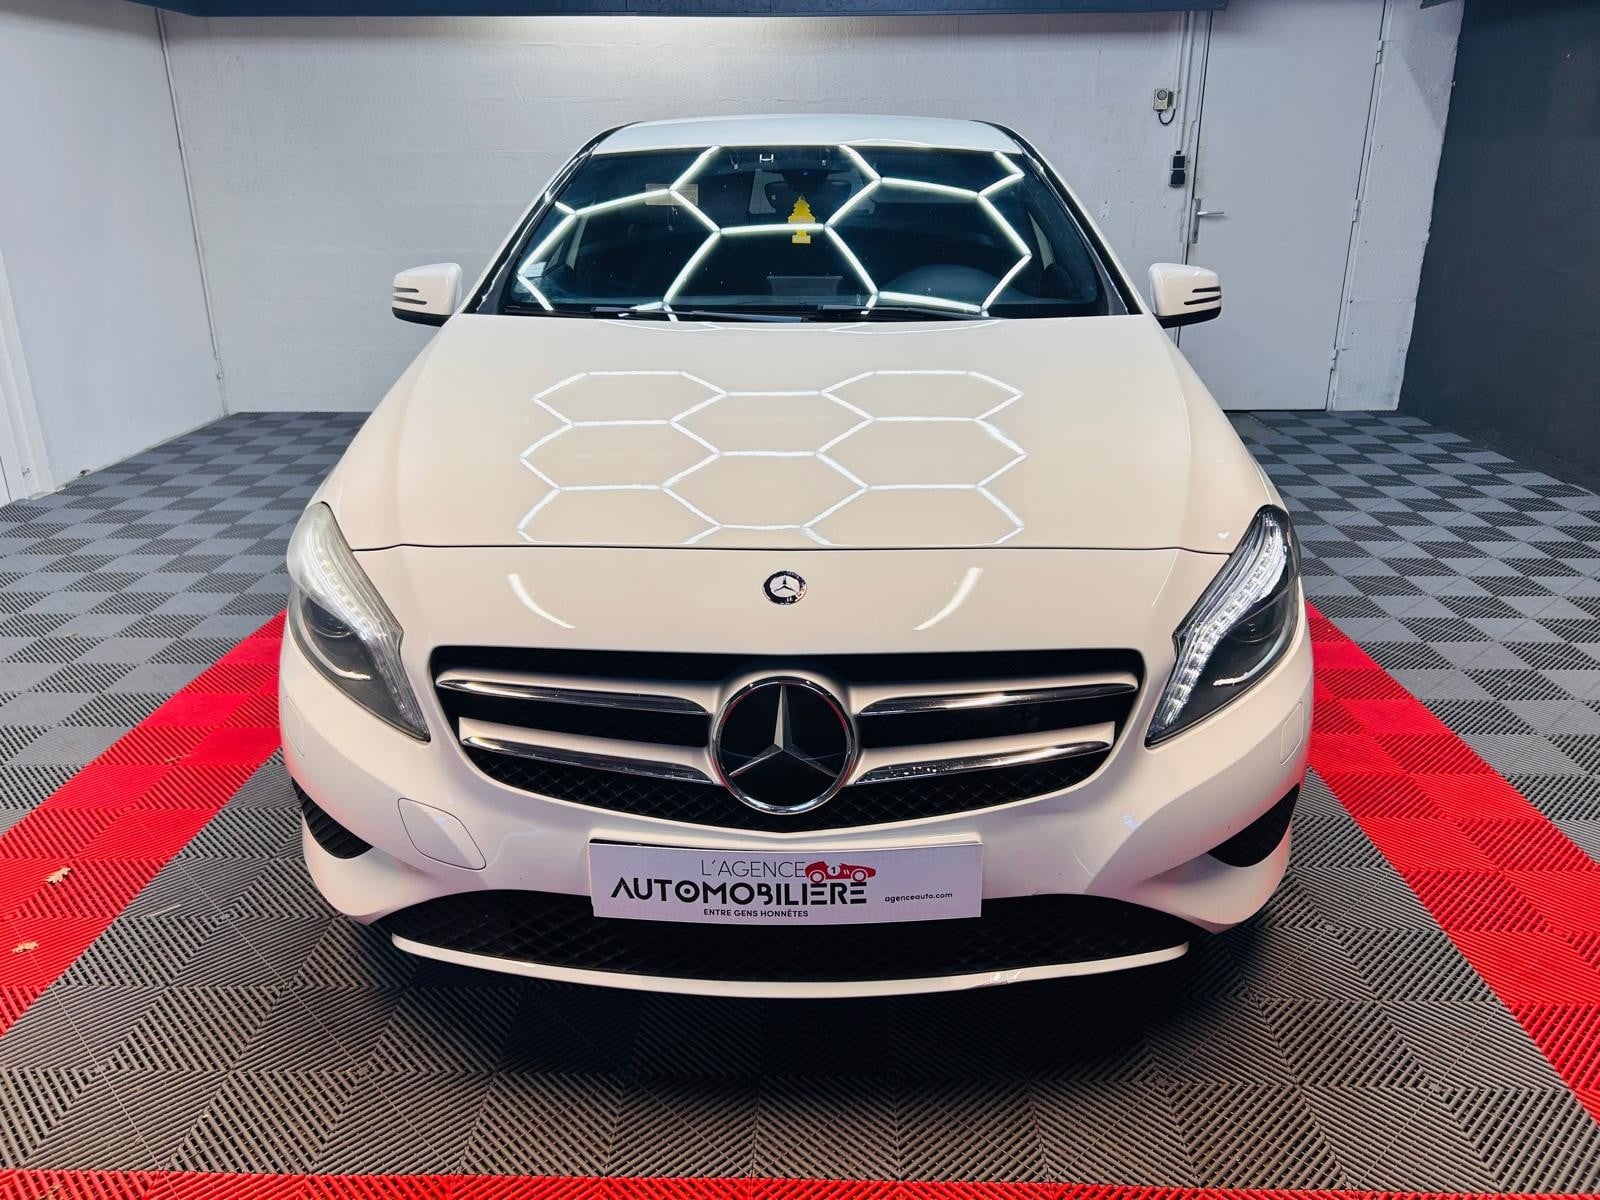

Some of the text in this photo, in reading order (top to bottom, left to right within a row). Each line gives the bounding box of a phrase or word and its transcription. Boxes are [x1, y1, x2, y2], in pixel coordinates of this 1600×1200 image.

[884, 893, 953, 904] agenceauto.com
[703, 908, 809, 918] ENTRE GENS HONNÊTES
